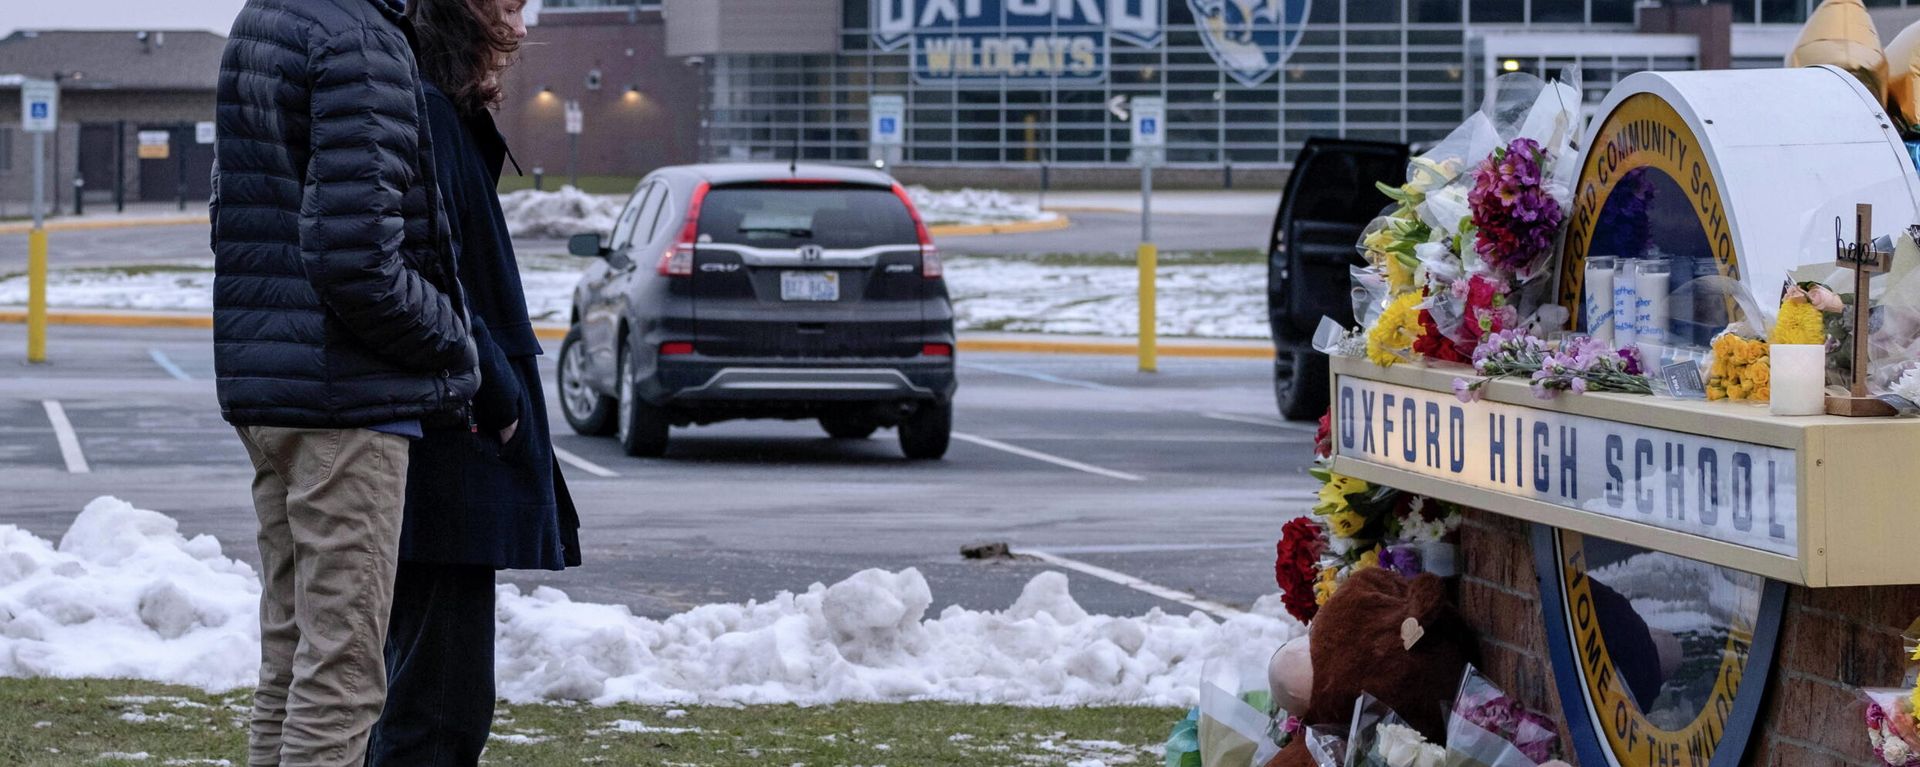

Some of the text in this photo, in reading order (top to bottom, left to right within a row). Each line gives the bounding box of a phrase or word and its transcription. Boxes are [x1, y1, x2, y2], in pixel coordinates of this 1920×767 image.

[924, 37, 1095, 76] WILDCATS
[1564, 183, 1597, 313] XFORD
[1598, 119, 1687, 186] COMMUNITY
[1341, 386, 1785, 539] OXFORD HIGH SCHOOL
[1569, 551, 1750, 767] HOME OF THE WILDCA
